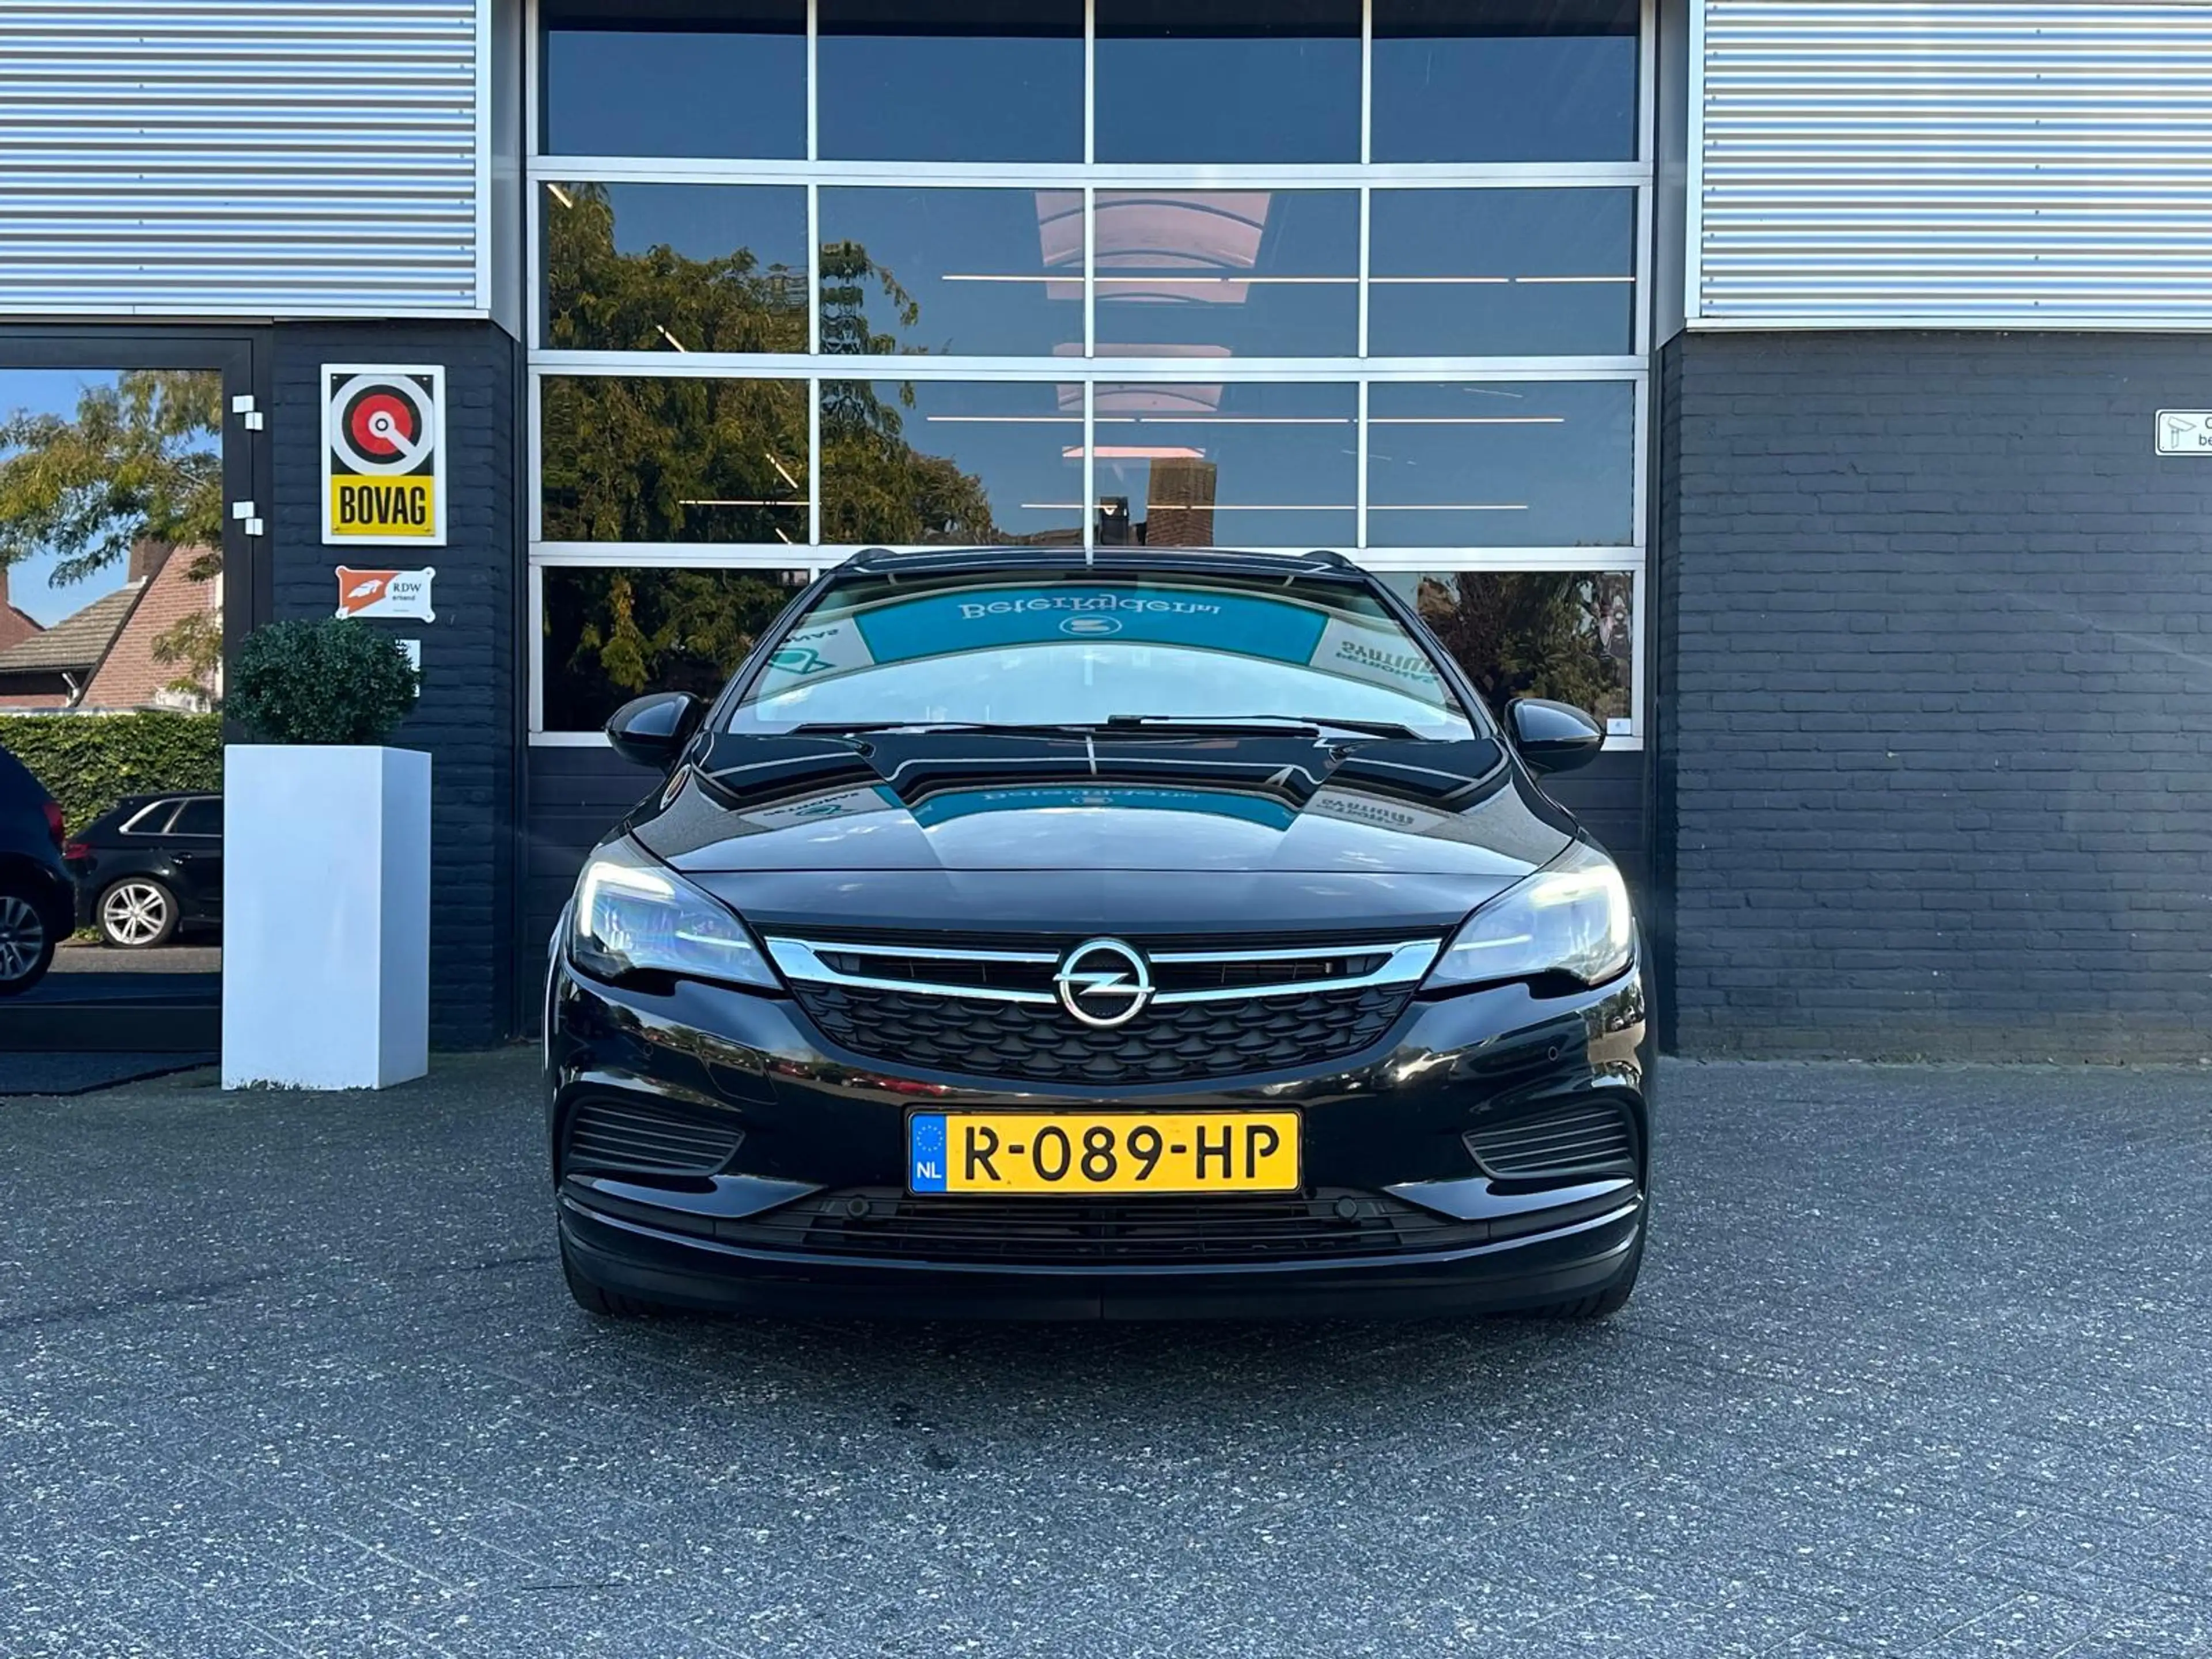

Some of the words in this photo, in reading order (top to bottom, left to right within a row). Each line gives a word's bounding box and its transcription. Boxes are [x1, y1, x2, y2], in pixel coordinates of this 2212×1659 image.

[340, 486, 426, 525] BOVAG
[393, 582, 422, 593] RDW
[965, 1125, 1279, 1181] R-089-HP
[916, 1161, 942, 1179] NL
